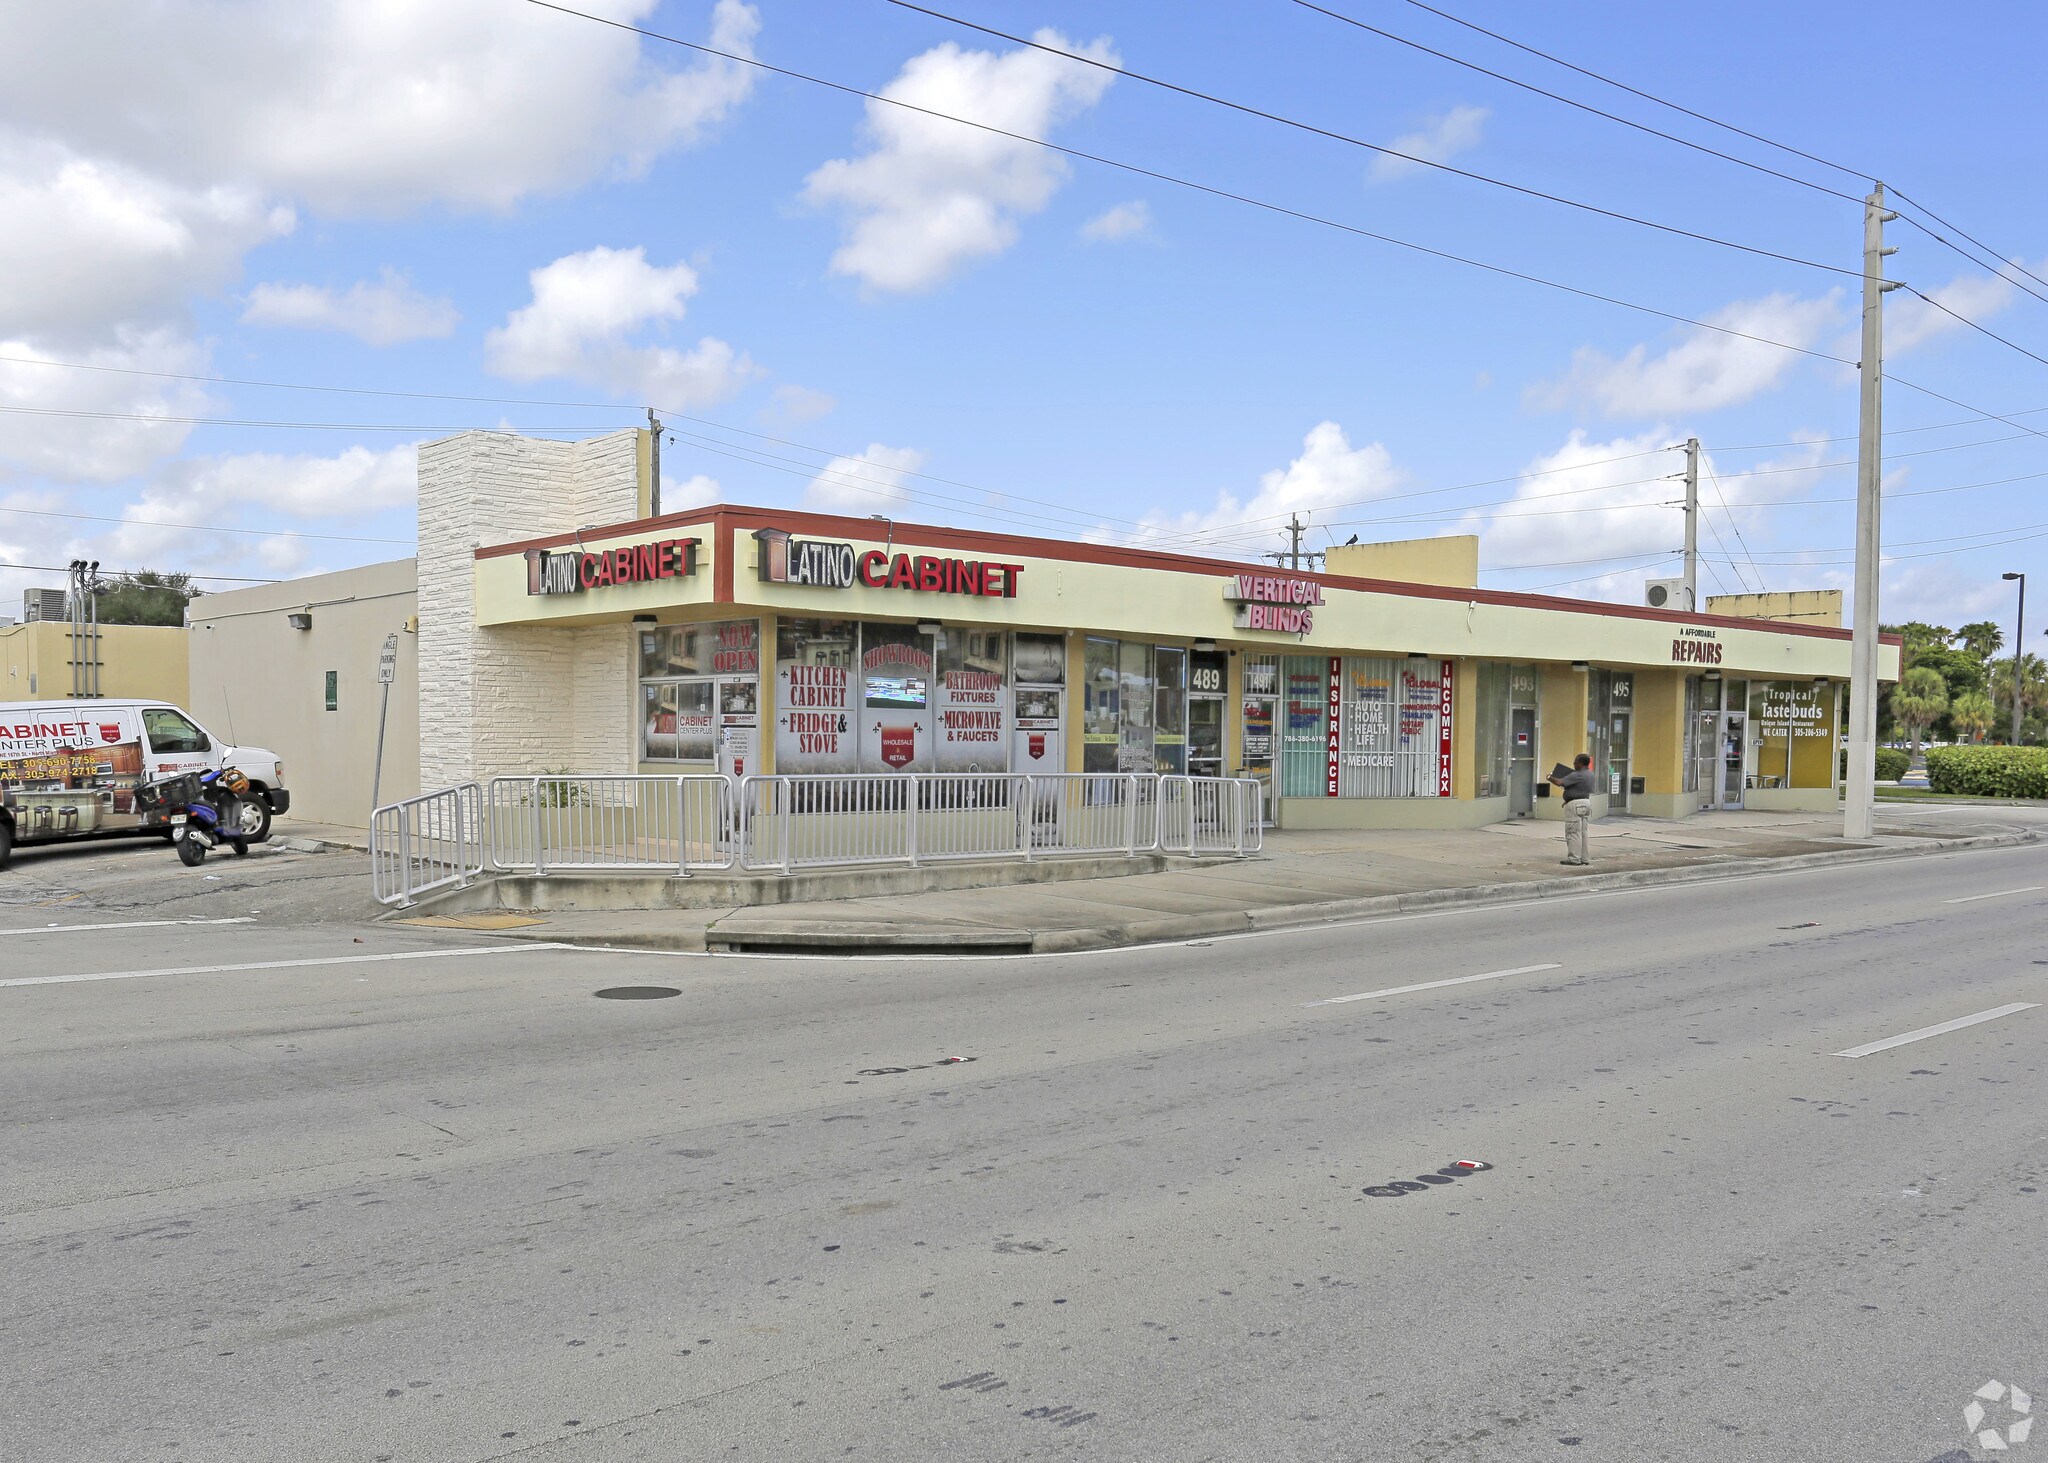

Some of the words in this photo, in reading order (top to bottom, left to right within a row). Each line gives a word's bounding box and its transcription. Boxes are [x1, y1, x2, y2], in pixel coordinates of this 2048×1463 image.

[539, 552, 576, 594] LATINO
[580, 538, 697, 589] CABINET
[787, 543, 855, 588] LATINO
[860, 550, 1025, 598] CABINET
[1239, 575, 1325, 606] VERTICAL
[1250, 605, 1313, 635] BLINDS
[719, 624, 753, 649] NOW
[1685, 628, 1716, 638] AFFORDABLE
[383, 640, 395, 649] ANGLE
[1672, 639, 1722, 664] REPAIRS
[381, 655, 395, 663] PARKING
[714, 650, 757, 672] OPEN
[863, 643, 932, 673] SHOWROOM
[381, 669, 392, 678] ONLY
[790, 665, 847, 687] KITCHEN
[944, 671, 1001, 691] BATHROOM
[1192, 668, 1220, 690] 489
[1409, 680, 1441, 688] GLOBAL
[1512, 675, 1534, 692] 493
[1613, 681, 1630, 697] 495
[790, 687, 847, 707] CABINET
[950, 691, 996, 703] FIXTURES
[1441, 664, 1450, 740] INCOME
[1769, 689, 1811, 702] Tropical
[1354, 701, 1381, 712] AUTO
[680, 716, 713, 726] CABINET
[944, 710, 1002, 730] MICROWAVE
[1354, 712, 1383, 723] HOME
[1329, 661, 1339, 792] INSURANCE
[1354, 723, 1389, 734] HEALTH
[1763, 728, 1770, 736] WE
[1771, 728, 1788, 736] CATER
[52, 737, 94, 748] PLUS
[799, 734, 838, 753] STOVE
[947, 731, 955, 742] &
[957, 731, 999, 742] FAUCETS
[1356, 735, 1375, 746] LIFE
[22, 755, 96, 768] 305-690-7758
[1348, 756, 1394, 767] MEDICARE
[24, 766, 98, 779] 305-974-2718
[1441, 755, 1450, 792] TAX
